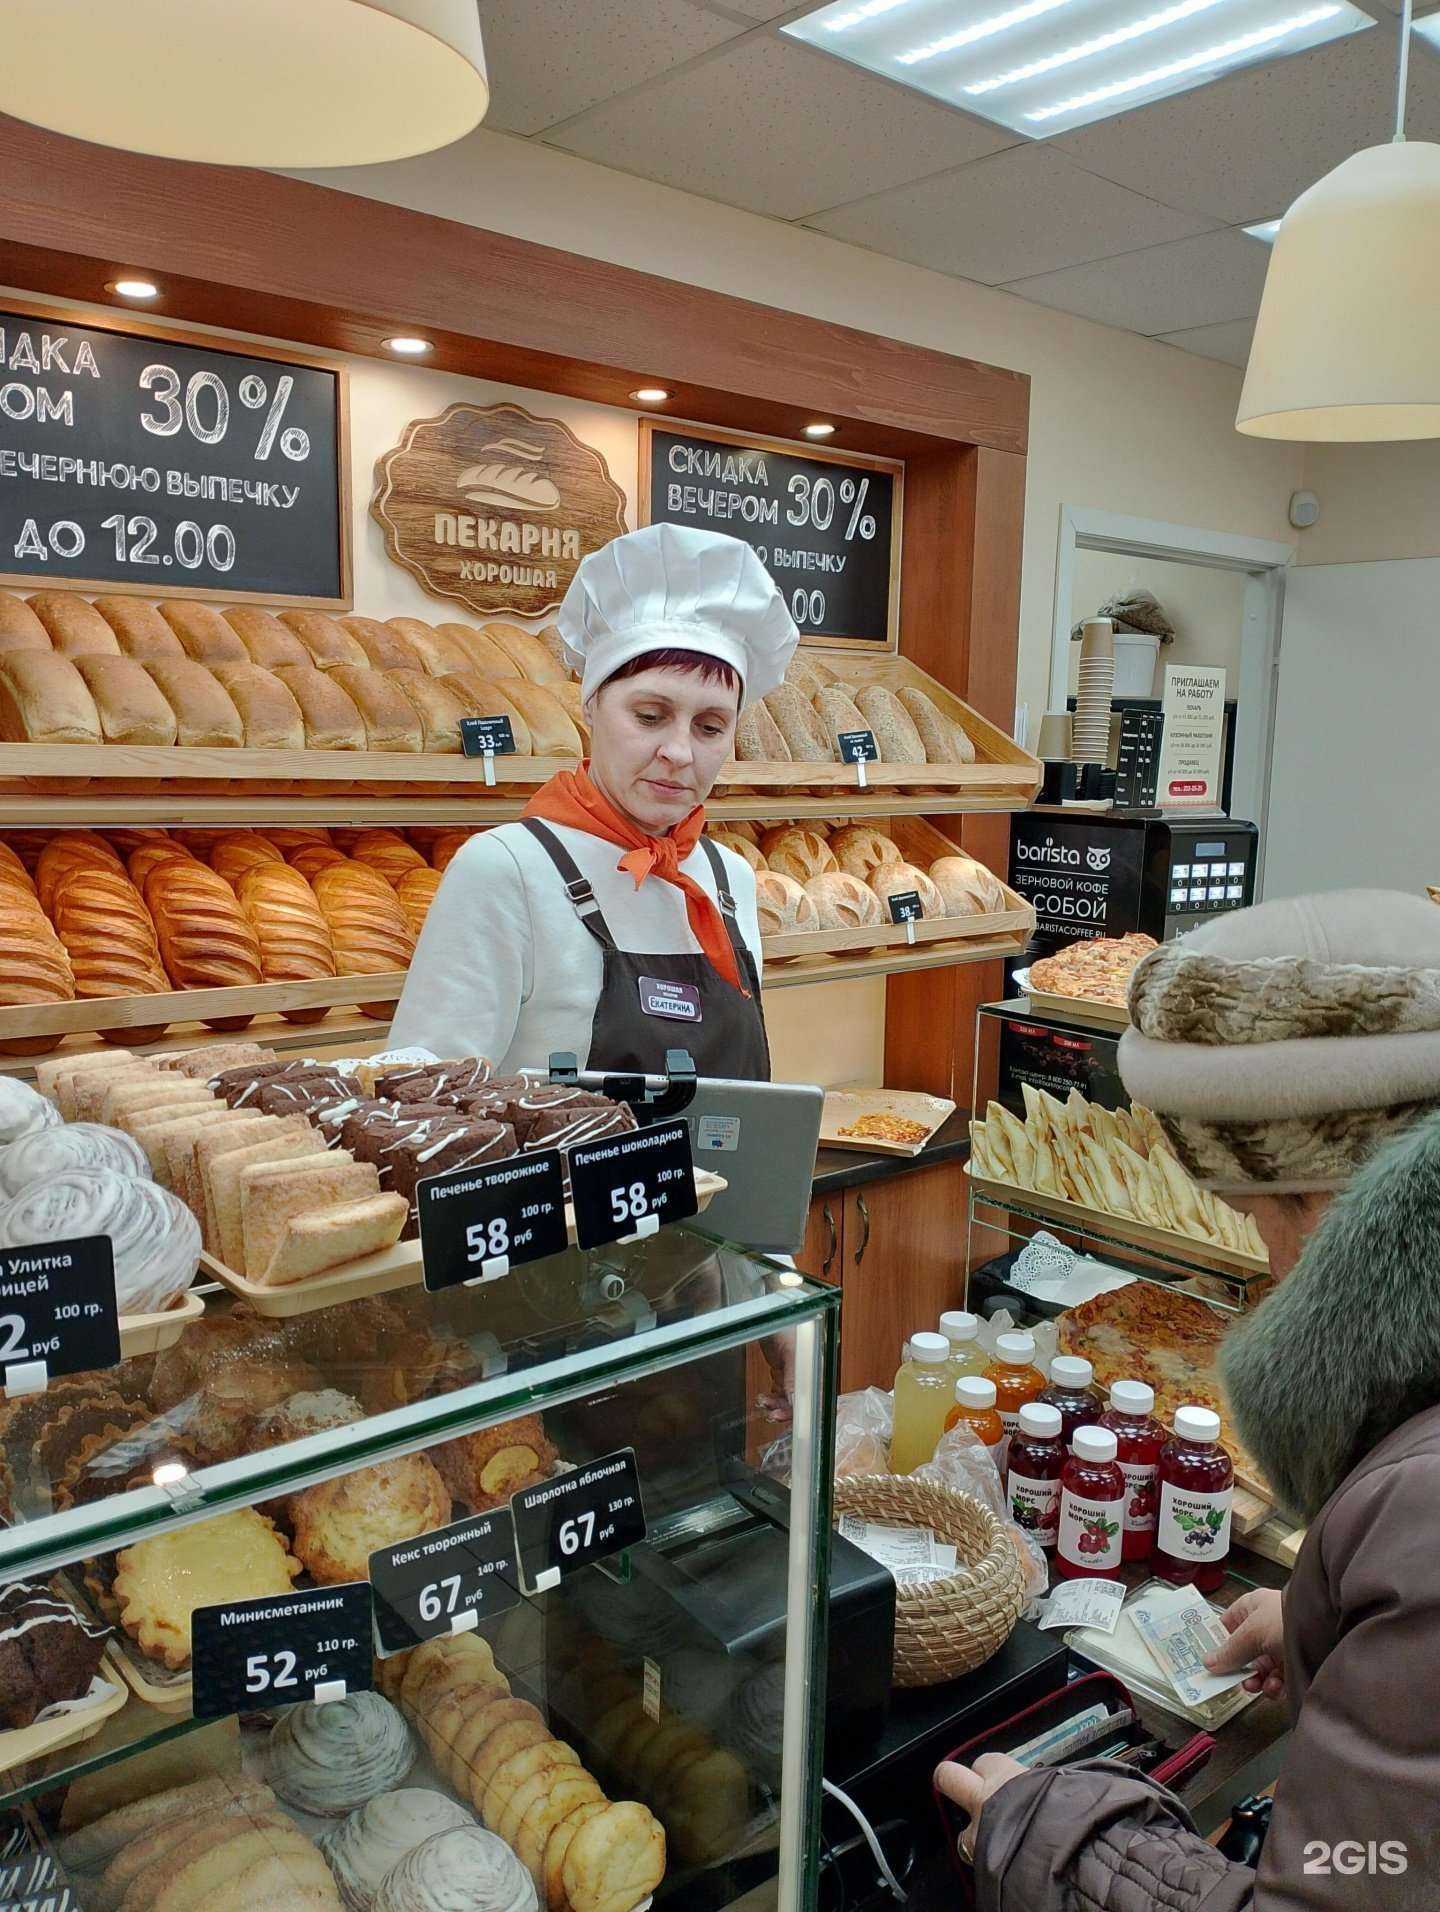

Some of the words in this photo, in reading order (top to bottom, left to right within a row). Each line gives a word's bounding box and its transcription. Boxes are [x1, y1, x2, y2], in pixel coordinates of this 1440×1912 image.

[0, 327, 100, 378] ДКА
[139, 364, 311, 461] 30%
[668, 445, 769, 486] СКИДКА
[166, 471, 301, 509] ВЫПЕЧКУ
[667, 484, 779, 525] ВЕЧЕРОМ
[786, 474, 876, 541] 30%
[14, 519, 86, 561] ДО
[101, 514, 237, 572] 12.00
[434, 512, 580, 561] ПЕКАРНЯ
[774, 547, 847, 573] ВЫПЕЧКУ
[459, 560, 557, 589] ХОРОШАЯ
[1171, 676, 1219, 688] ПРИГЛАШАЕМ
[1176, 689, 1186, 697] НА
[1188, 689, 1214, 699] РАБОТУ
[478, 735, 495, 749] 33
[852, 746, 864, 757] 42
[1017, 837, 1080, 865] barista
[1016, 874, 1073, 891] ЗЕРНОВОЙ
[1076, 881, 1109, 895] КОФЕ
[900, 906, 910, 918] 38
[1033, 893, 1107, 920] СОБОЙ
[575, 1147, 620, 1166] Печенье
[622, 1128, 683, 1154] шоколадное
[430, 1178, 483, 1200] Печенье
[486, 1161, 550, 1187] творожное
[657, 1170, 672, 1183] 100
[674, 1168, 686, 1180] гр.
[521, 1206, 539, 1218] 100
[541, 1202, 554, 1215] гр.
[610, 1182, 648, 1223] 58
[652, 1193, 668, 1209] руб
[466, 1217, 510, 1262] 58
[514, 1229, 533, 1246] руб
[8, 1254, 72, 1275] Улитка
[0, 1274, 49, 1297] ицей
[54, 1304, 80, 1320] 100
[84, 1303, 104, 1317] гр.
[32, 1336, 60, 1356] руб
[524, 1481, 578, 1509] Шарлотка
[579, 1460, 626, 1486] яблочная
[1016, 1484, 1052, 1497] ХОРОШИЙ
[608, 1500, 622, 1513] 130
[623, 1497, 635, 1510] гр.
[1015, 1493, 1036, 1504] МОРС
[1069, 1503, 1106, 1517] ХОРОШИЙ
[1173, 1497, 1212, 1510] ХОРОШИЙ
[1068, 1511, 1088, 1524] МОРС
[1172, 1506, 1194, 1518] МОРС
[392, 1547, 420, 1567] Кекс
[423, 1521, 492, 1556] творожный
[559, 1511, 596, 1556] 67
[600, 1524, 615, 1540] руб
[477, 1563, 494, 1577] 140
[495, 1559, 508, 1573] гр.
[419, 1575, 462, 1621] 67
[465, 1589, 483, 1606] руб
[220, 1598, 344, 1626] Минисметанник
[317, 1639, 339, 1652] 110
[342, 1637, 359, 1650] гр.
[246, 1650, 298, 1692] 52
[305, 1664, 328, 1680] руб
